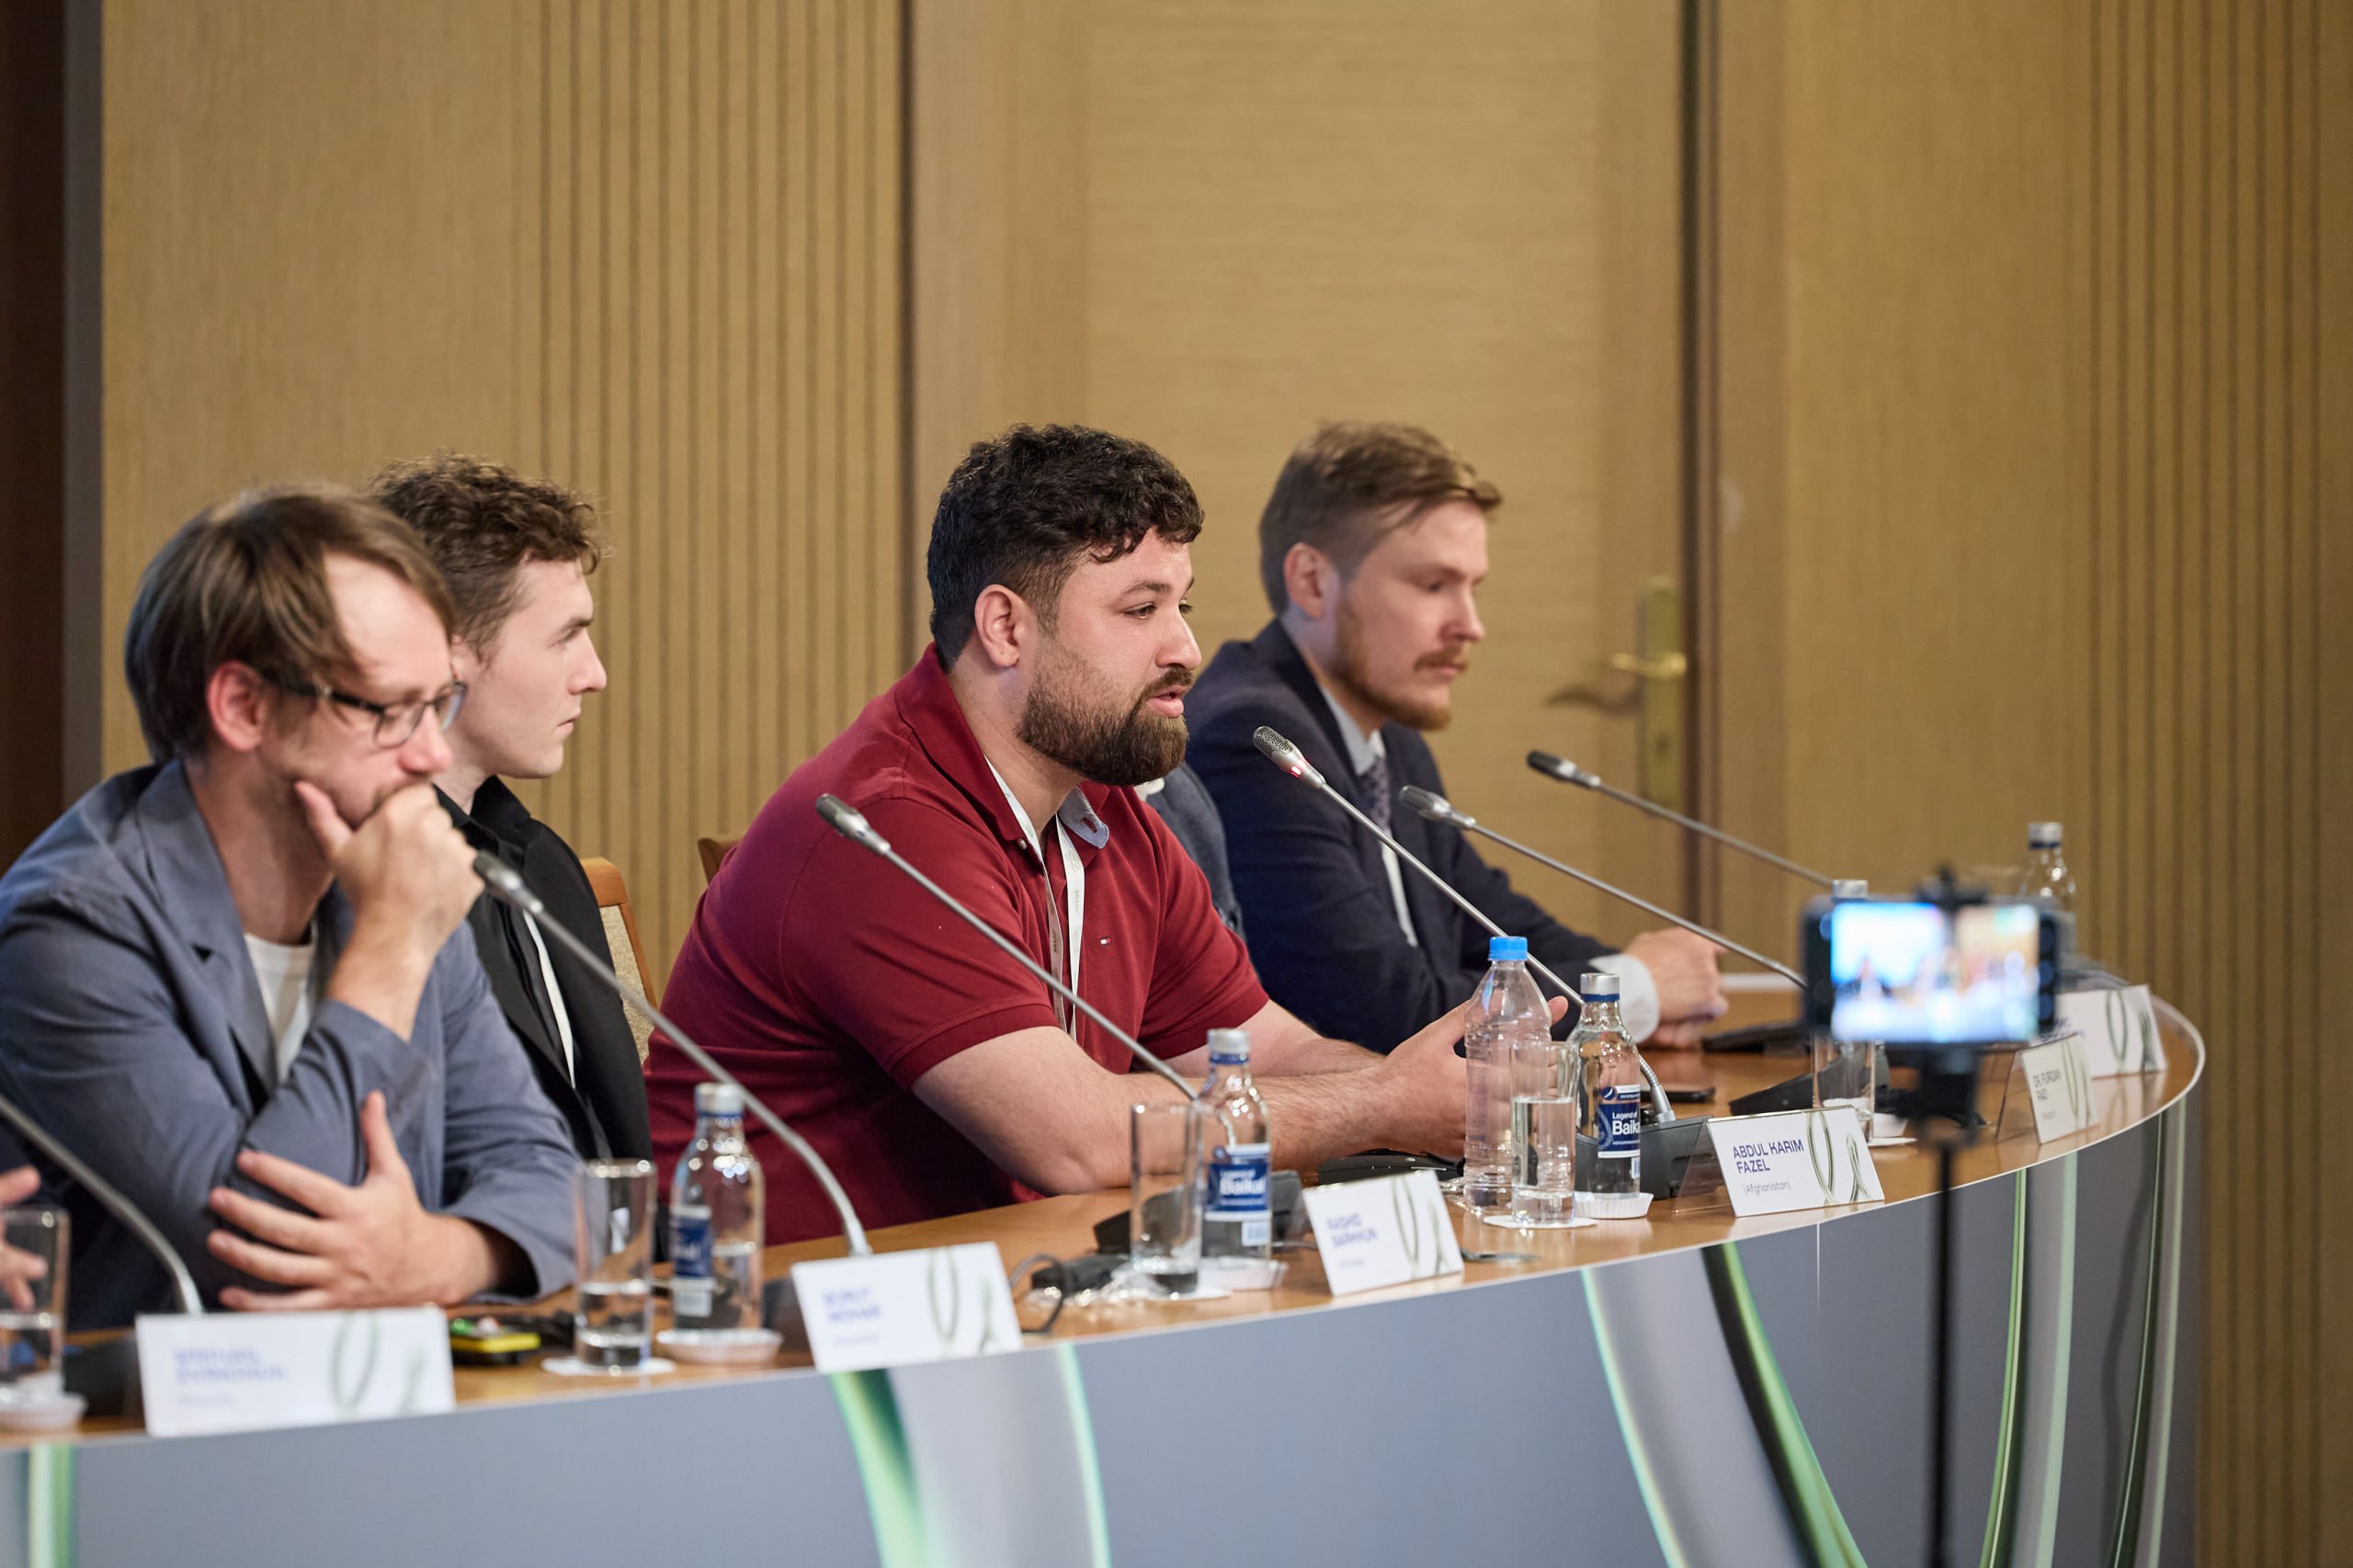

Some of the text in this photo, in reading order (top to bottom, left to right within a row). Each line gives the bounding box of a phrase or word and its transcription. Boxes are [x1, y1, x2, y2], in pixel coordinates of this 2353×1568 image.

[1612, 1111, 1632, 1120] Legend
[1733, 1139, 1805, 1160] ABDUL KARIM
[1736, 1158, 1771, 1175] FAZEL
[1743, 1178, 1792, 1196] (Afghanistan)
